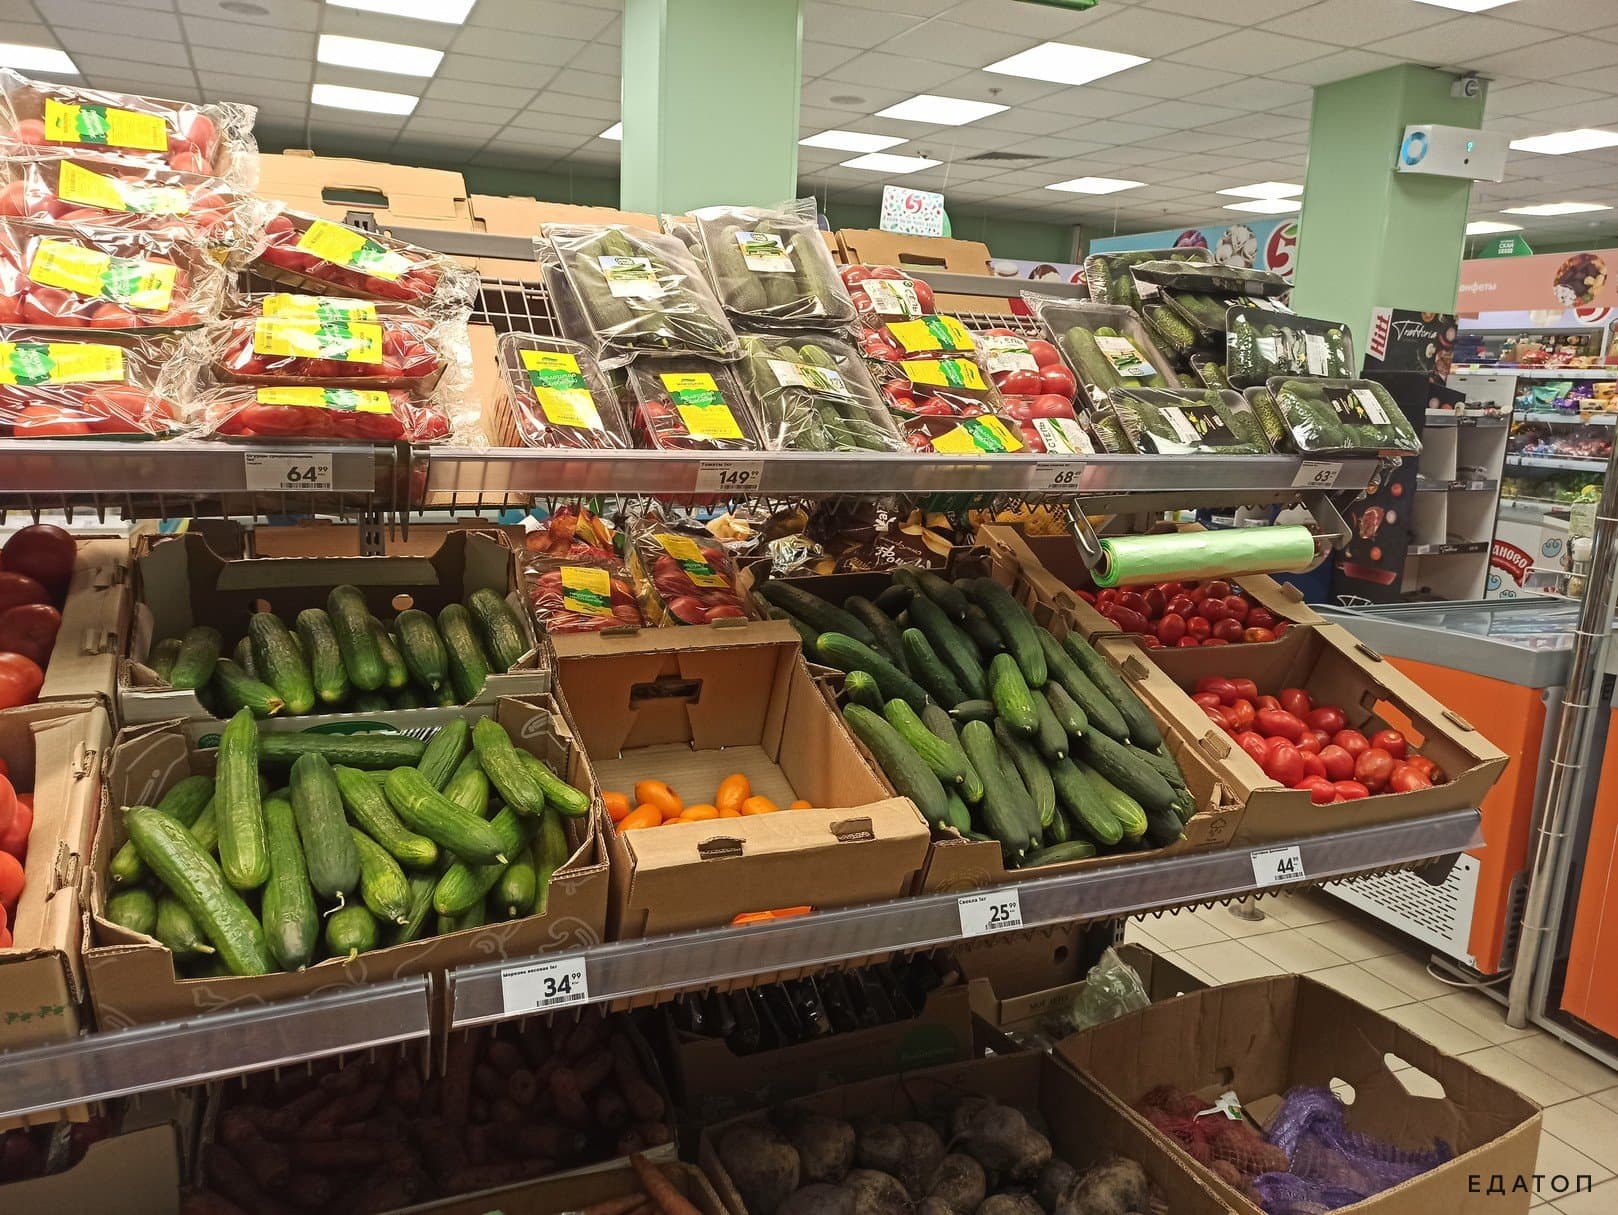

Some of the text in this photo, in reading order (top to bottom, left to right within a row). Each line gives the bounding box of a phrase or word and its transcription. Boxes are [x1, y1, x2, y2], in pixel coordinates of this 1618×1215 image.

[1459, 280, 1496, 295] онфеты
[1370, 315, 1390, 356] Hitt
[287, 466, 317, 482] 64
[720, 471, 750, 484] 149
[1055, 471, 1074, 483] 68
[1314, 470, 1331, 481] 63
[1492, 545, 1527, 568] АНОВО
[1277, 857, 1294, 873] 44
[990, 904, 1010, 922] 25
[544, 972, 581, 998] 34 99
